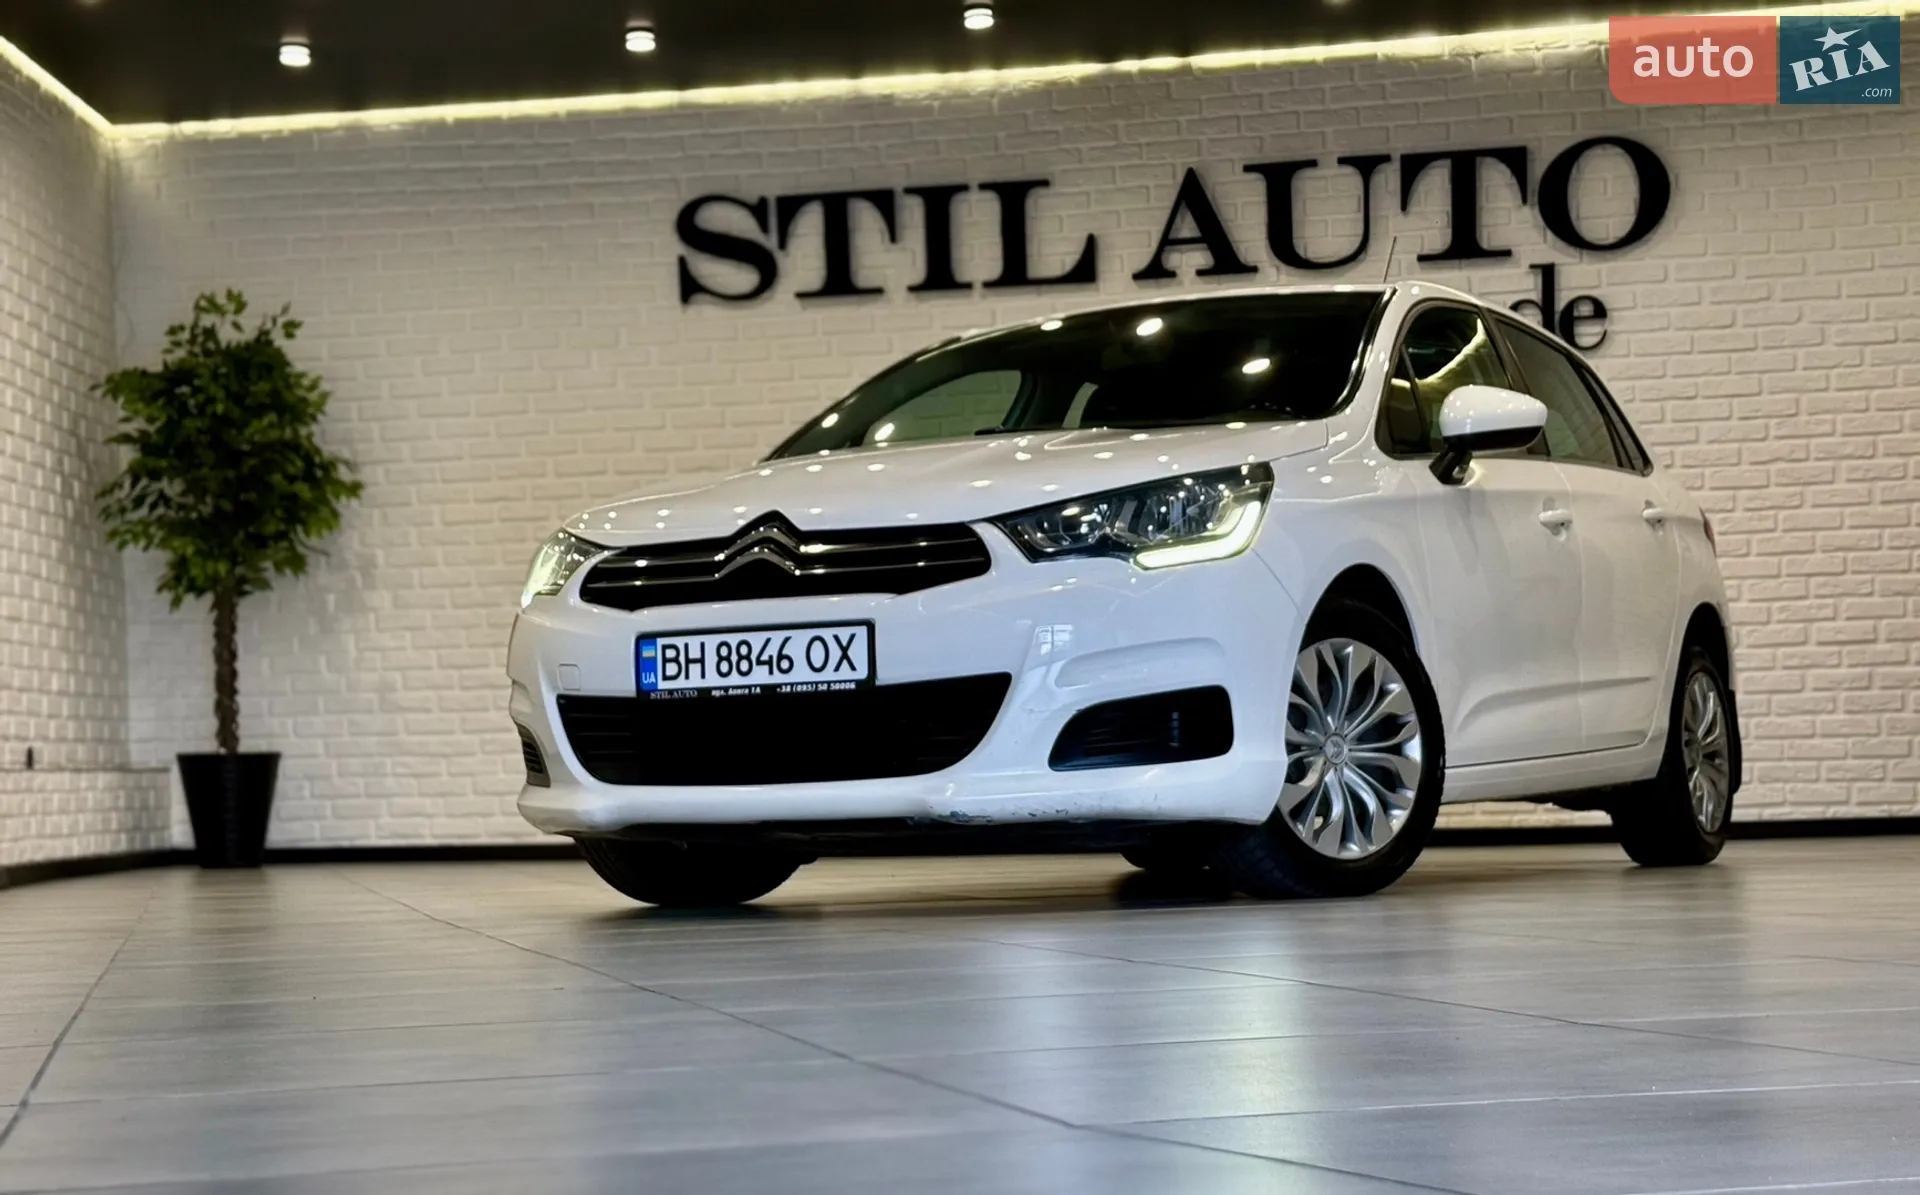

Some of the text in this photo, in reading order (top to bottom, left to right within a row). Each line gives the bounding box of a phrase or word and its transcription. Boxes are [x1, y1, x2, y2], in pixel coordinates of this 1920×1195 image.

[676, 136, 1672, 307] STIL AUTO
[661, 633, 857, 682] BH 8846 OX
[641, 672, 656, 683] UA
[650, 689, 698, 700] STIL AUTO
